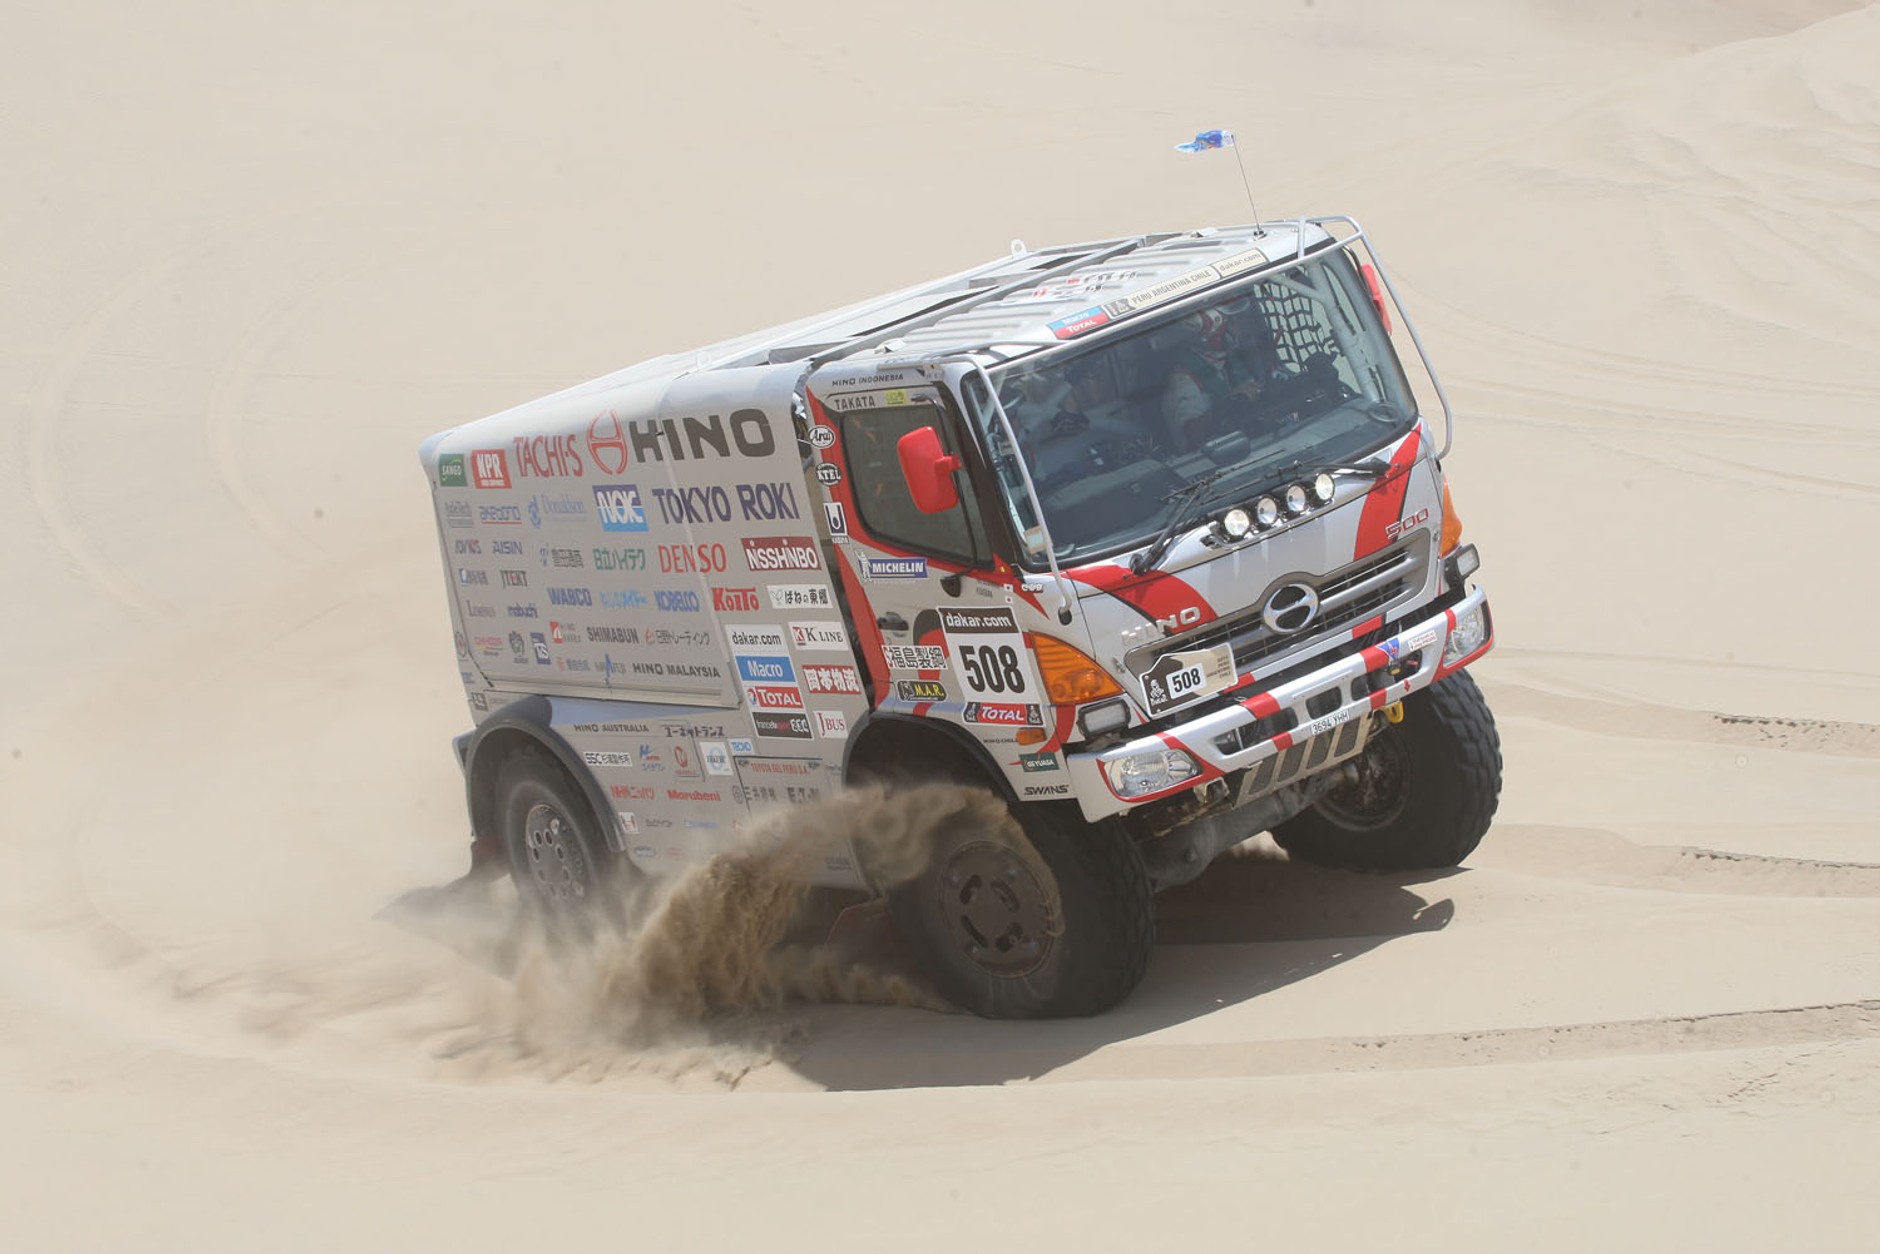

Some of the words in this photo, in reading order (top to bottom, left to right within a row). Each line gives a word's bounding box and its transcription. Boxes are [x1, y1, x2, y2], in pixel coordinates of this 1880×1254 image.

[1219, 252, 1261, 273] dakar.com
[1131, 290, 1151, 305] PERU
[1152, 277, 1191, 299] ARGENTINA
[1192, 270, 1213, 284] CHILE
[1068, 319, 1098, 333] TOTAL
[832, 378, 855, 386] HINO
[858, 374, 904, 386] INDONESIA
[834, 396, 876, 411] TAKATA
[628, 408, 776, 463] HINO
[812, 429, 831, 442] Arai
[513, 434, 583, 477] TACHI-S
[477, 453, 503, 478] NPR
[597, 490, 644, 523] NOK
[652, 485, 732, 525] TOKYO
[736, 482, 801, 521] ROKI
[1385, 508, 1429, 539] 500
[492, 541, 523, 555] AISIN
[592, 548, 646, 571] 日立ハイテク
[658, 543, 726, 573] DENSO
[872, 562, 924, 573] MICHELIN
[500, 570, 528, 588] JTEKT
[547, 587, 592, 606] WABCO
[654, 590, 700, 612] KOBELCO
[946, 614, 1012, 628] dakar.com
[1121, 606, 1201, 646] HINO
[586, 626, 640, 644] SHIMABUN
[732, 632, 782, 646] dakar.com
[805, 627, 819, 642] K
[820, 630, 844, 643] LINE
[632, 662, 664, 675] HINO
[666, 663, 721, 678] MALAYSIA
[747, 661, 783, 678] Macro
[958, 645, 1025, 694] 508
[1172, 668, 1201, 693] 508
[758, 688, 801, 706] TOTAL
[914, 684, 944, 697] M.A.R.
[981, 706, 1025, 721] TOTAL
[574, 724, 600, 733] HINO
[602, 724, 650, 733] AUSTRALIA
[827, 718, 845, 732] BUS
[667, 789, 721, 801] Marubeni
[1025, 785, 1069, 796] SWANS
